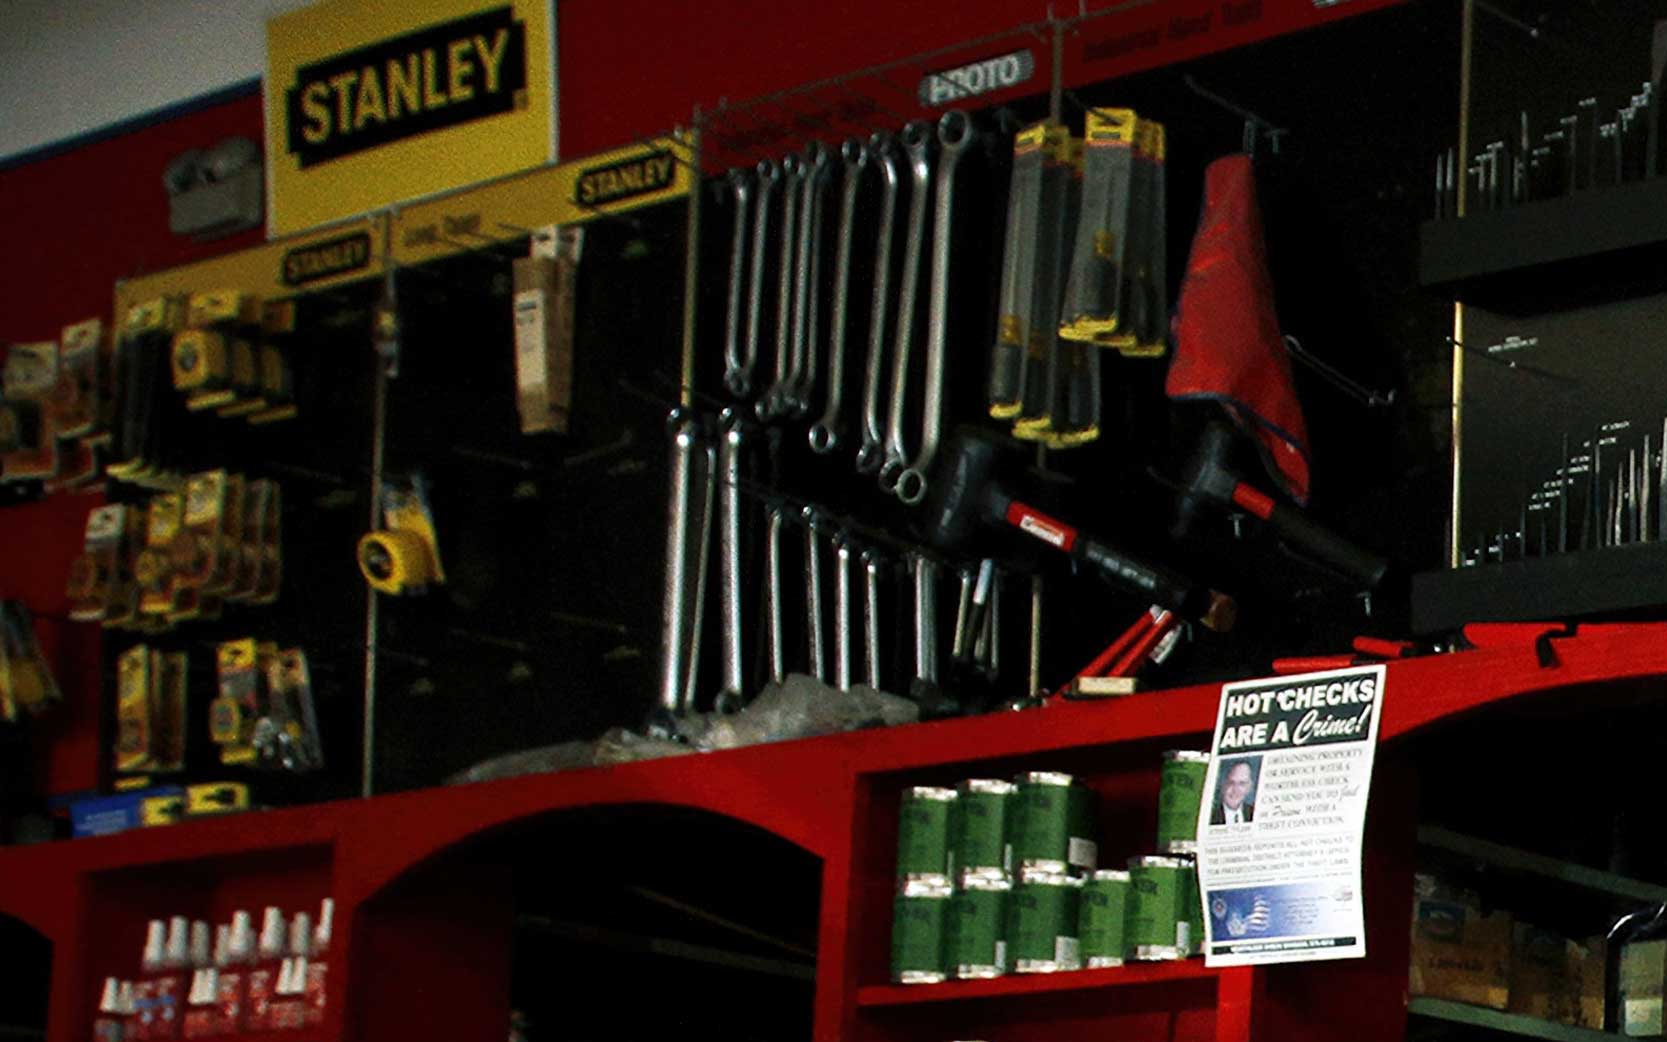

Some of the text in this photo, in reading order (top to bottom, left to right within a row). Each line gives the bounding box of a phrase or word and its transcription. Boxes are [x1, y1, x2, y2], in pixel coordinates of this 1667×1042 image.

[301, 28, 510, 144] STANLEY
[581, 154, 672, 202] STANLEY
[1226, 679, 1375, 717] HOT CHECKS
[1219, 703, 1372, 749] ARE A Crime!
